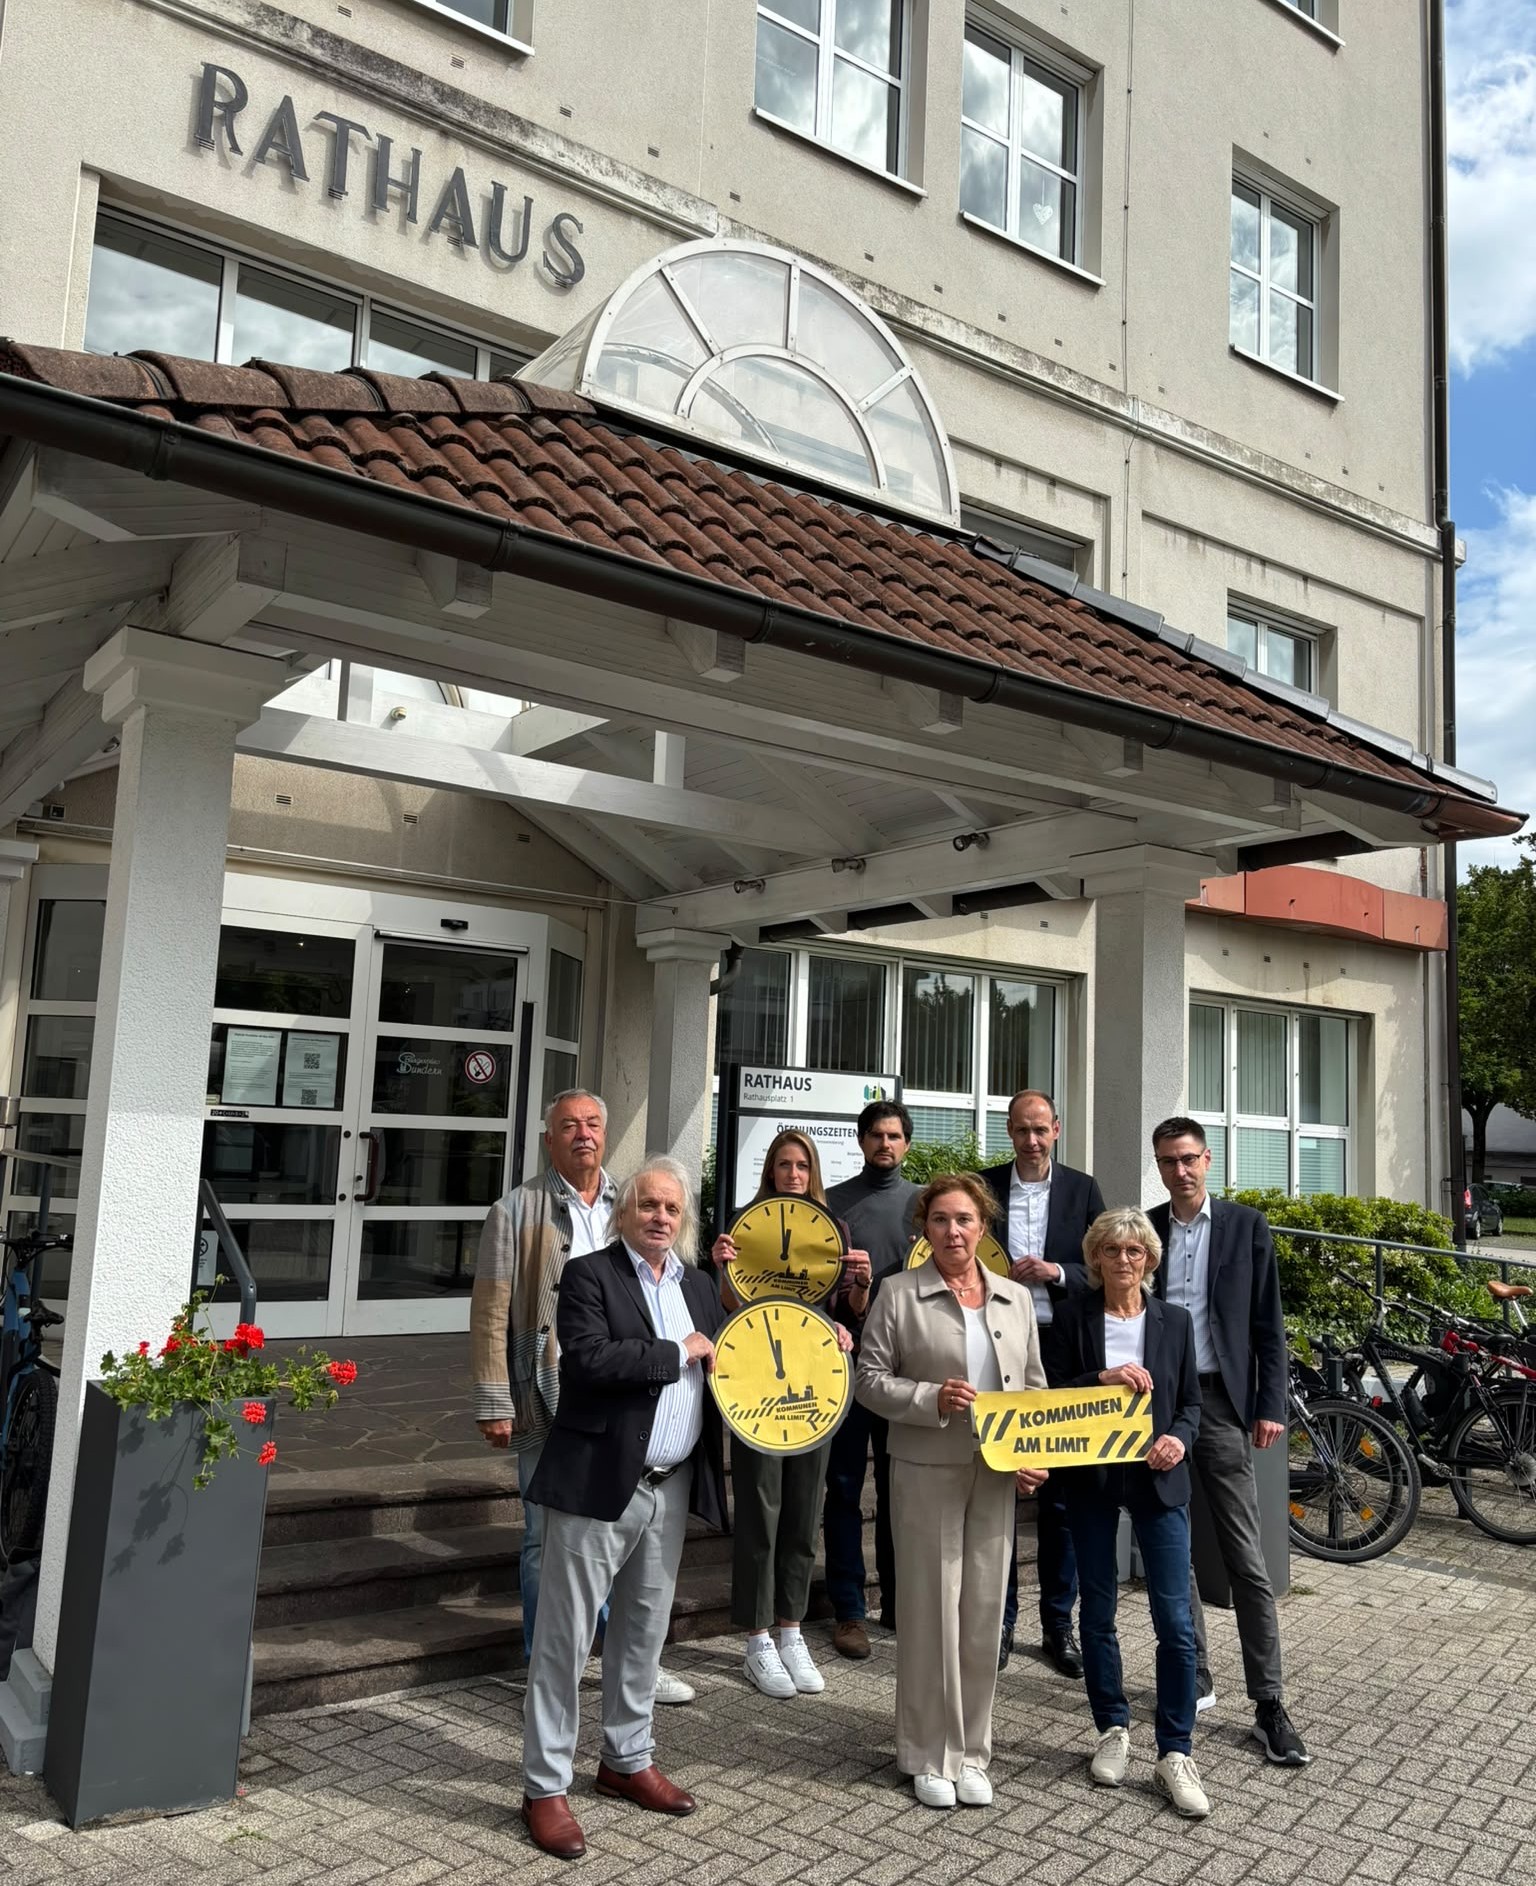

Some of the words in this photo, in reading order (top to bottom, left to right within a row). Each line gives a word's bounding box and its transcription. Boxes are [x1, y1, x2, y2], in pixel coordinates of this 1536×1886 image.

[194, 61, 586, 286] RATHAUS
[744, 1073, 812, 1092] RATHAUS
[743, 1092, 788, 1103] Rathausplatz
[775, 1401, 818, 1413] KOMMUNEN
[1019, 1397, 1123, 1429] KOMMUNEN
[1013, 1437, 1041, 1453] AM
[1046, 1437, 1090, 1453] LIMIT
